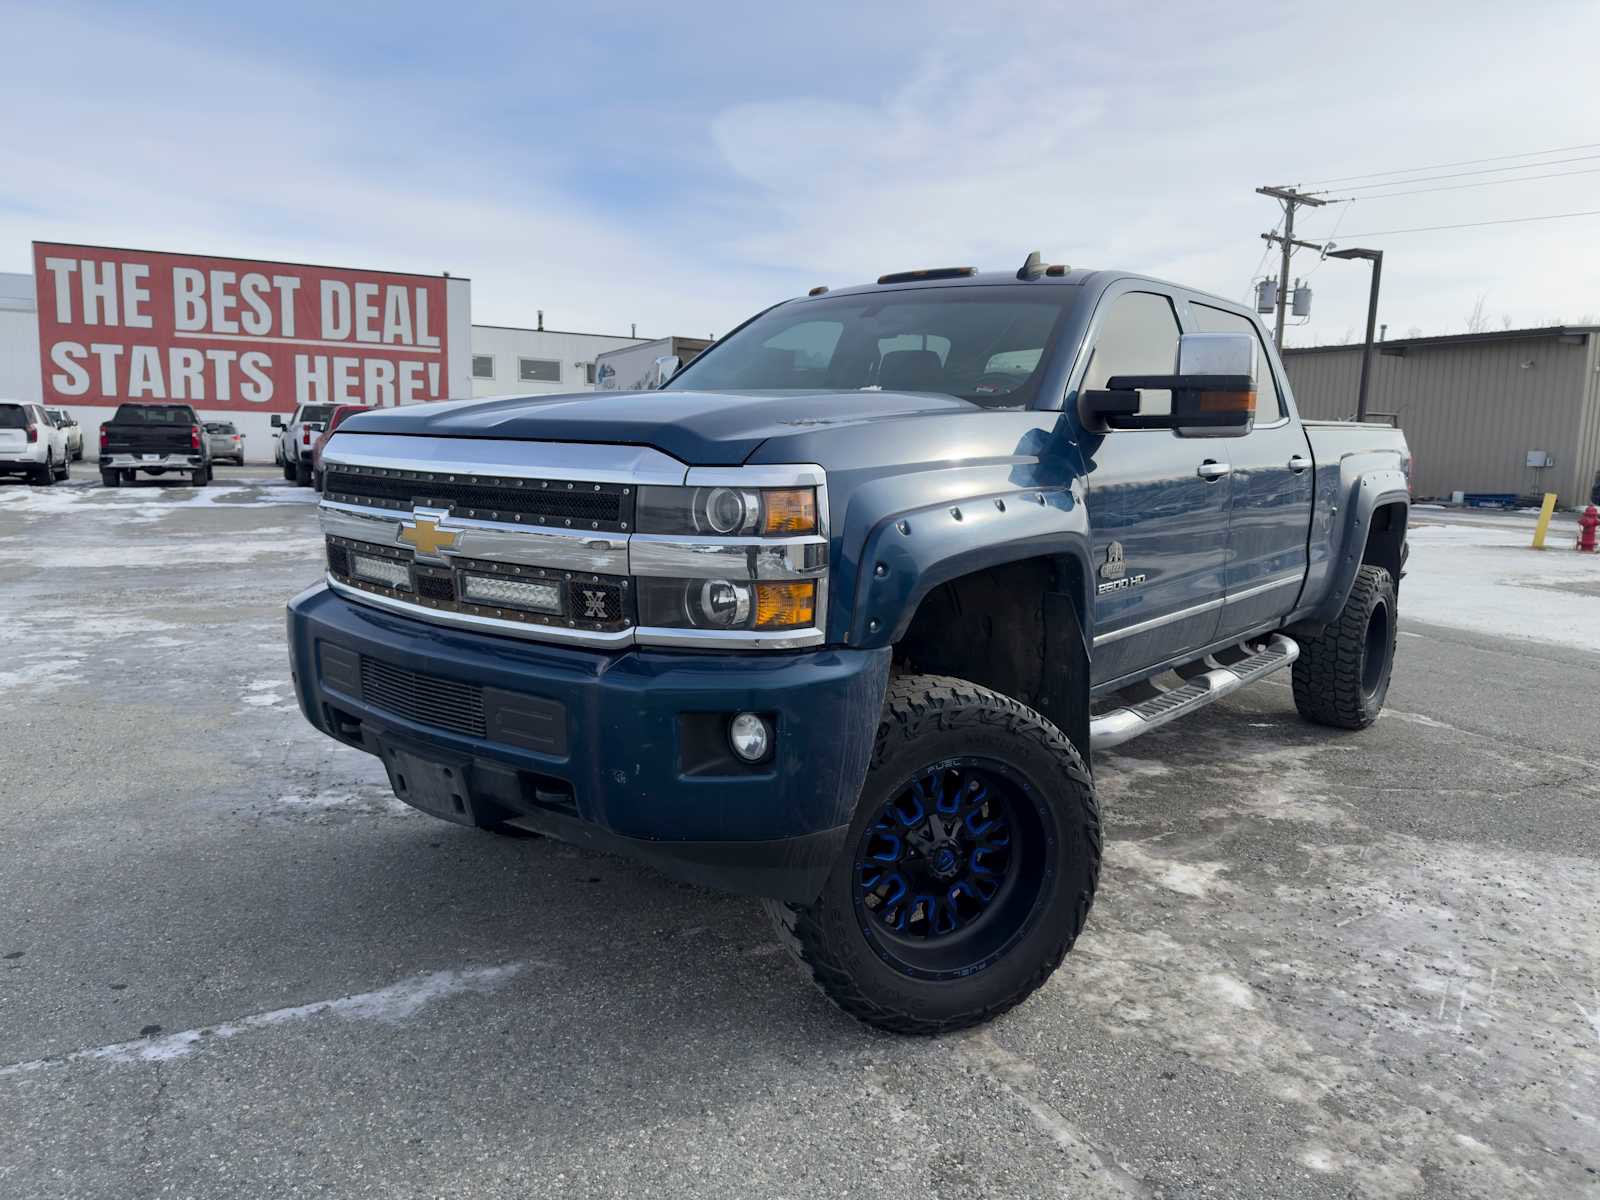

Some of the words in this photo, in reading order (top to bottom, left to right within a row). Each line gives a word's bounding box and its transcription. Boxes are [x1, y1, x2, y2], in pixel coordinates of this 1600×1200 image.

[45, 257, 153, 329] THE
[172, 267, 301, 337] BEST
[319, 279, 441, 347] DEAL
[50, 341, 274, 403] STARTS
[295, 354, 441, 406] HERE!
[1098, 579, 1128, 593] 2500
